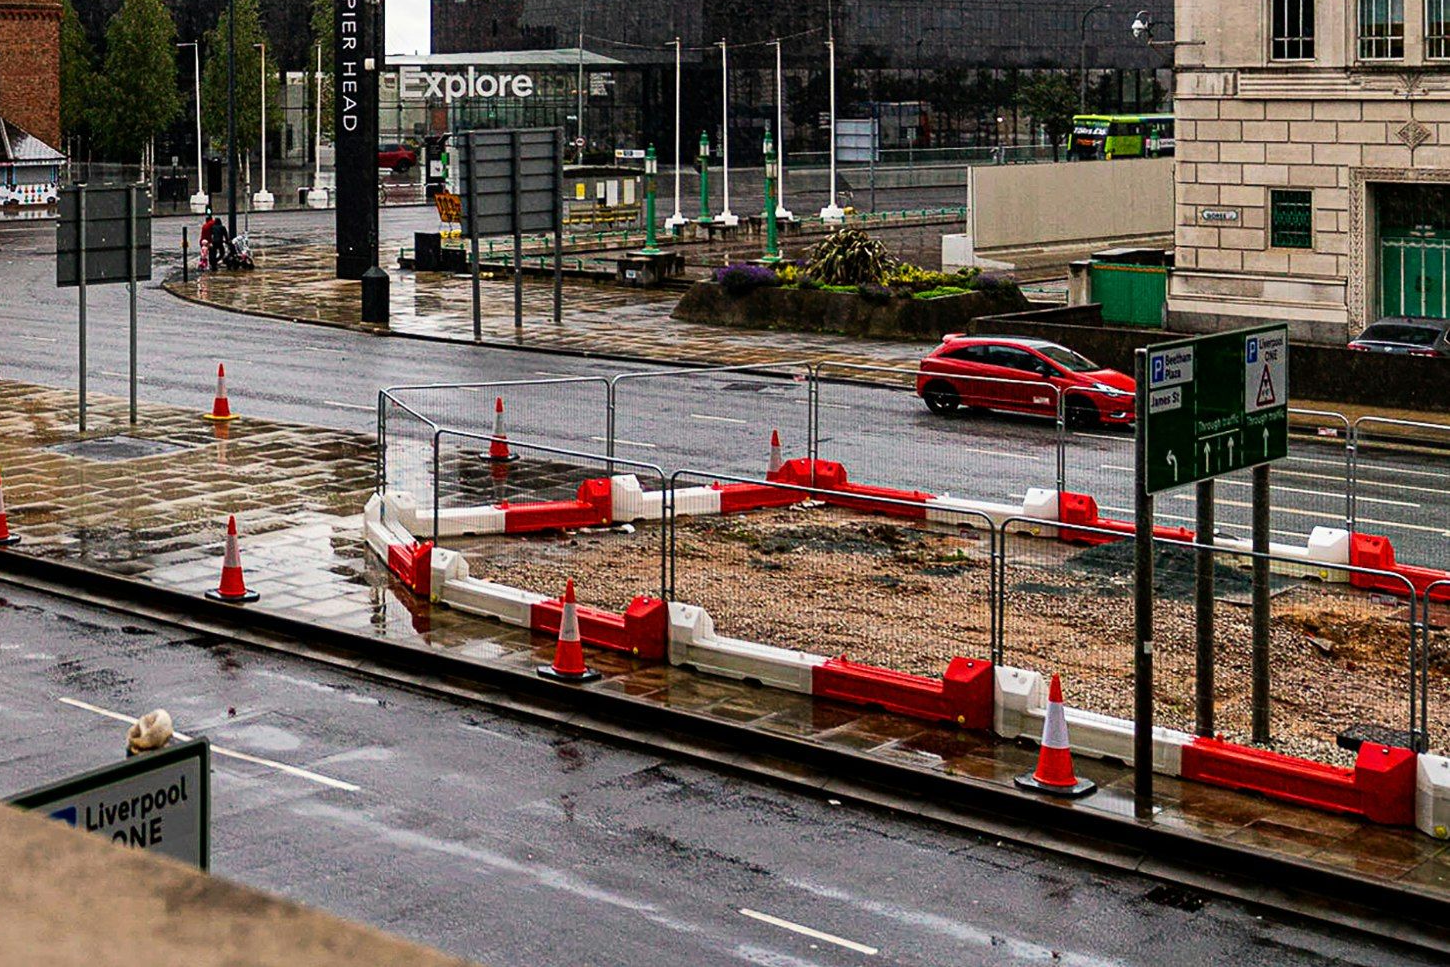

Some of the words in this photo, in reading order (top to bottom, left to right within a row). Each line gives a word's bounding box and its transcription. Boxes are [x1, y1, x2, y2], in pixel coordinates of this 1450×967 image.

[399, 66, 533, 103] Explore
[341, 62, 357, 132] HEAD
[1259, 336, 1284, 349] Liverpool
[1165, 353, 1192, 366] Beetham
[1265, 349, 1278, 362] ONE
[1154, 359, 1162, 380] P
[1165, 369, 1181, 380] Plaza
[1151, 394, 1170, 407] James
[1172, 391, 1180, 403] St
[1198, 418, 1221, 431] Through
[1222, 413, 1239, 426] traffic
[1246, 413, 1268, 427] Through
[1269, 408, 1285, 420] traffic
[86, 775, 188, 832] Liverpool
